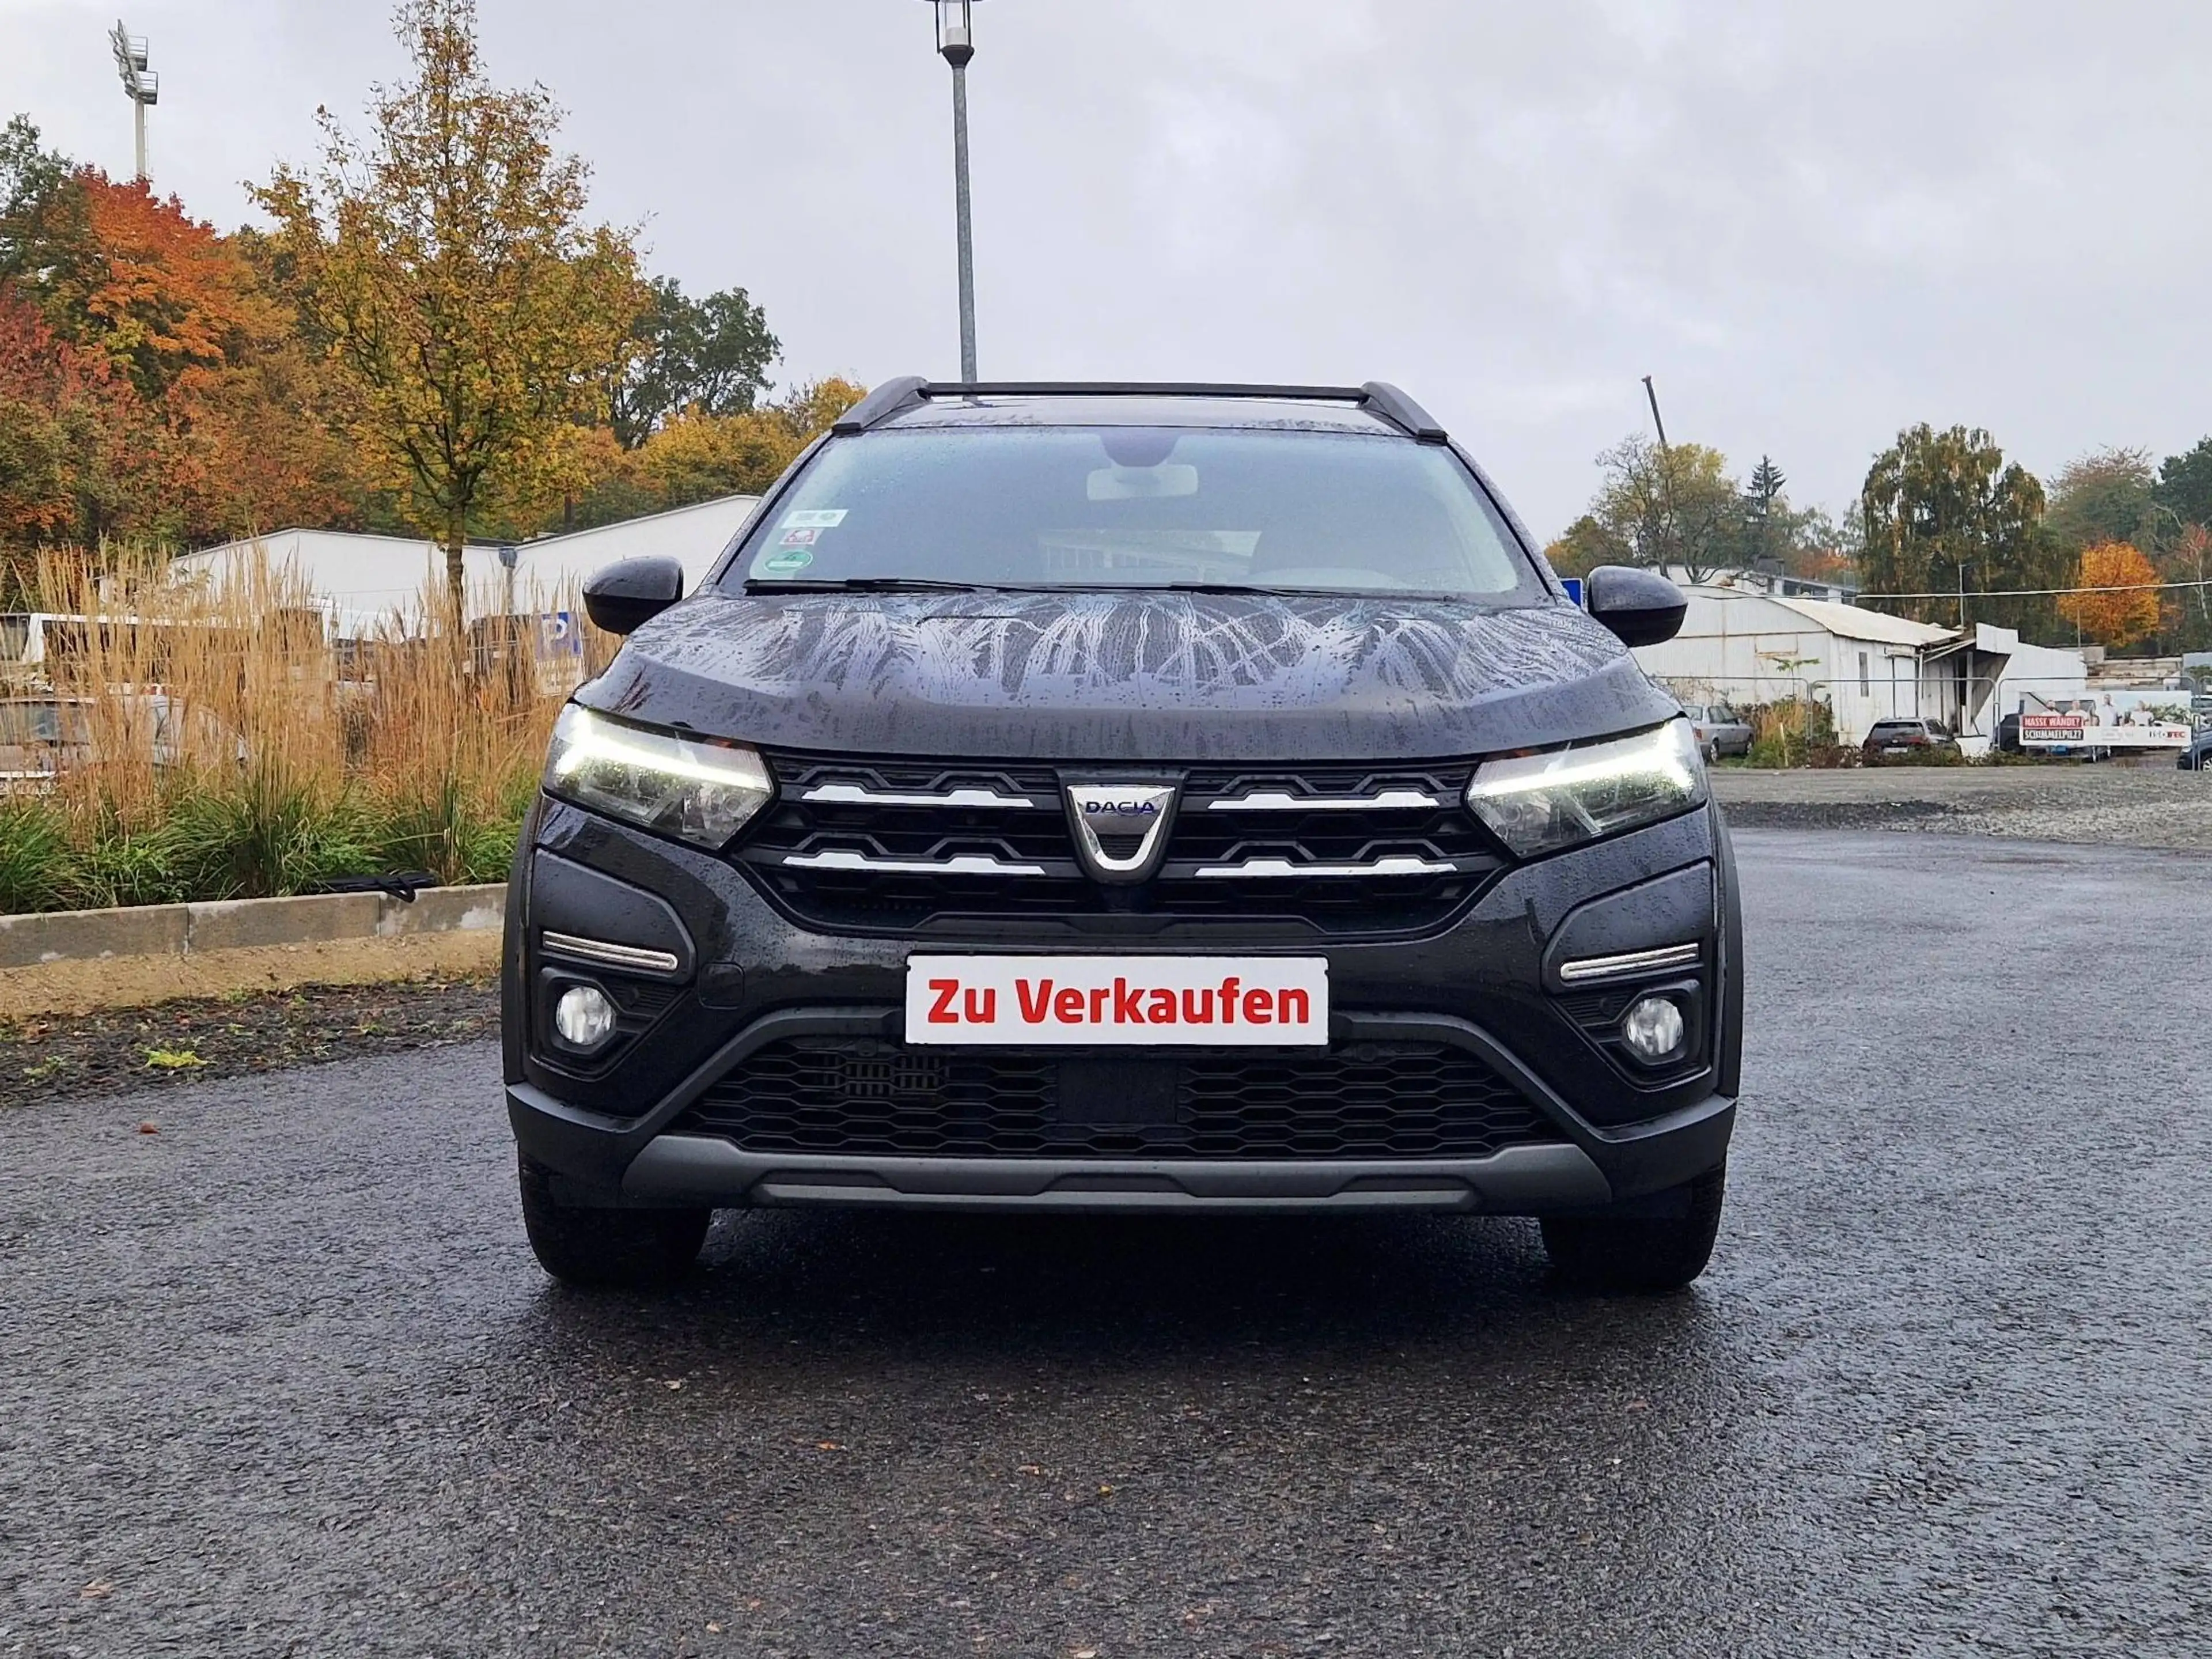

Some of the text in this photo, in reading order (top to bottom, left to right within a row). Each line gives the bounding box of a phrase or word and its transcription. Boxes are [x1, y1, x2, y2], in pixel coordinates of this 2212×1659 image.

[1086, 801, 1154, 814] DACIA
[927, 977, 1309, 1024] Zu Verkaufen
